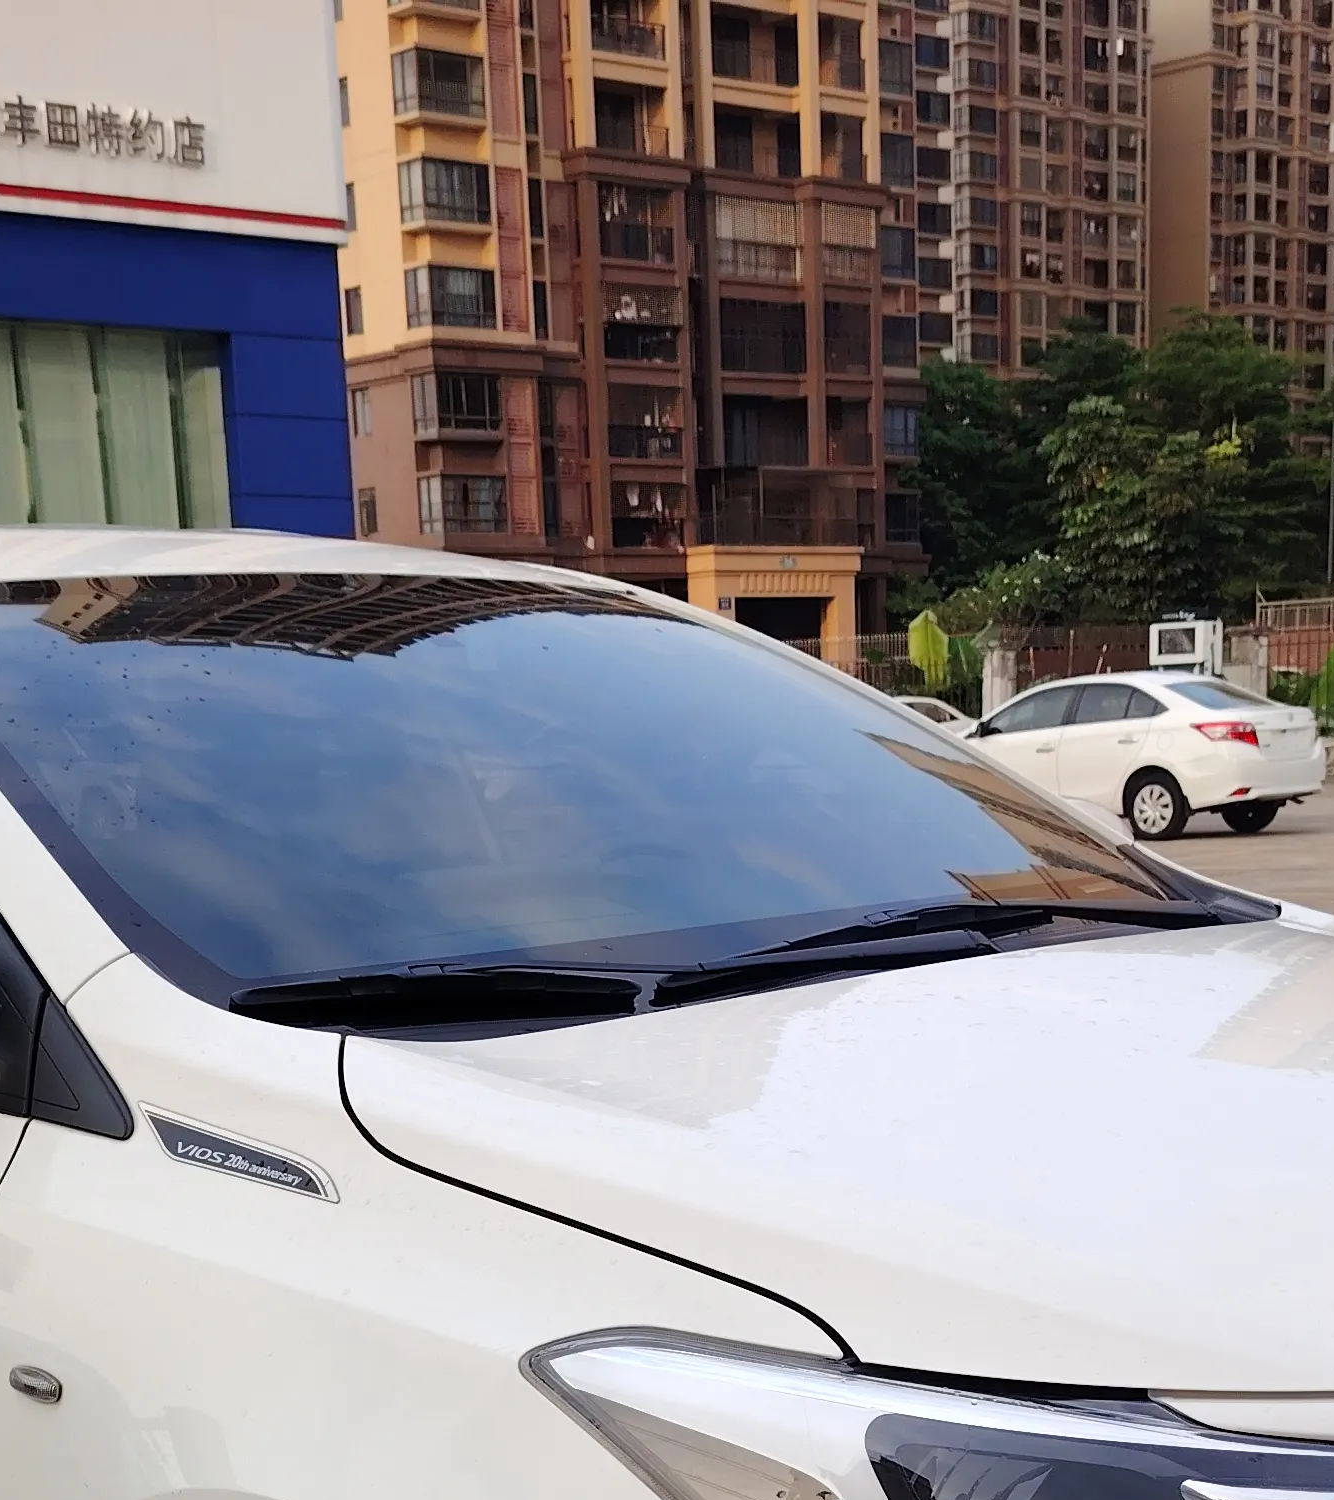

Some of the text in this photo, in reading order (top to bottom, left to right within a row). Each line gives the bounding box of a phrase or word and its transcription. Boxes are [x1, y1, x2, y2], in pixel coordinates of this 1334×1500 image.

[177, 1141, 303, 1186] VIOS 20th anniversary
